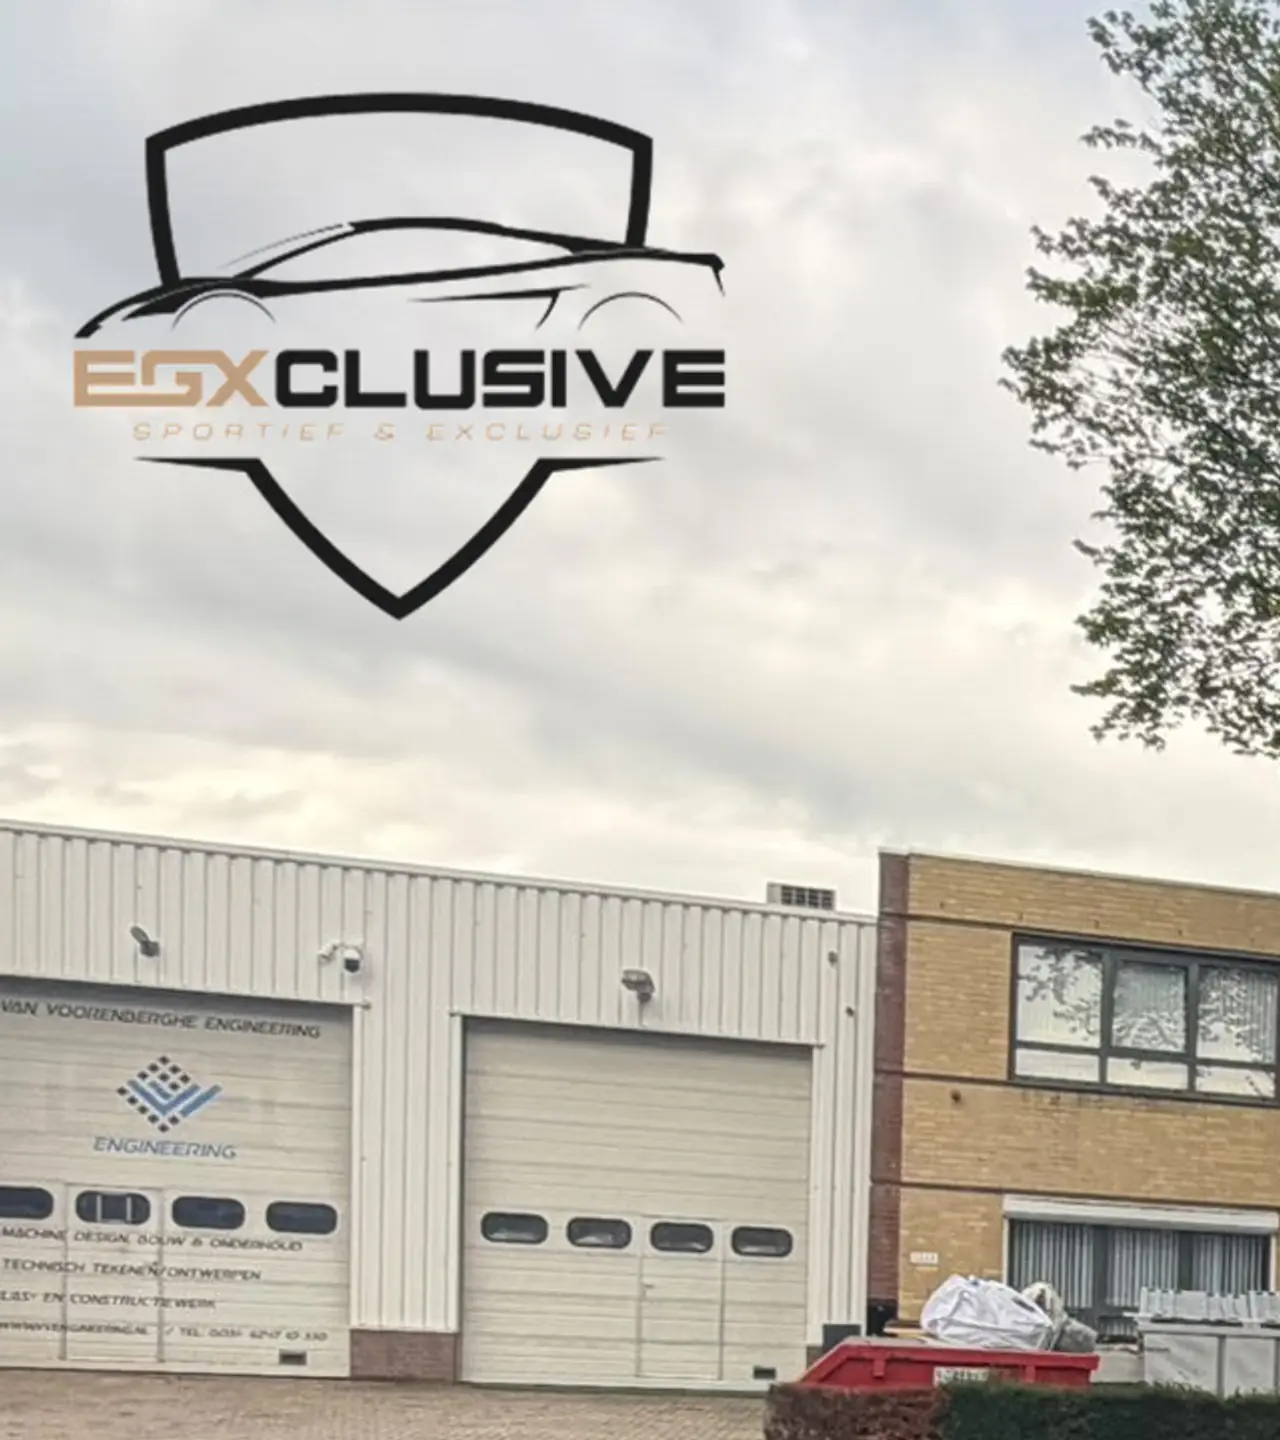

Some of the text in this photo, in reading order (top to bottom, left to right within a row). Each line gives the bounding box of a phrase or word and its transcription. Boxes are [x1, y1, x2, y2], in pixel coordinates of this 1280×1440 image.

[2, 1001, 38, 1015] VAN
[204, 1016, 321, 1039] ENGINEERING
[93, 1136, 238, 1159] ENGINEERING
